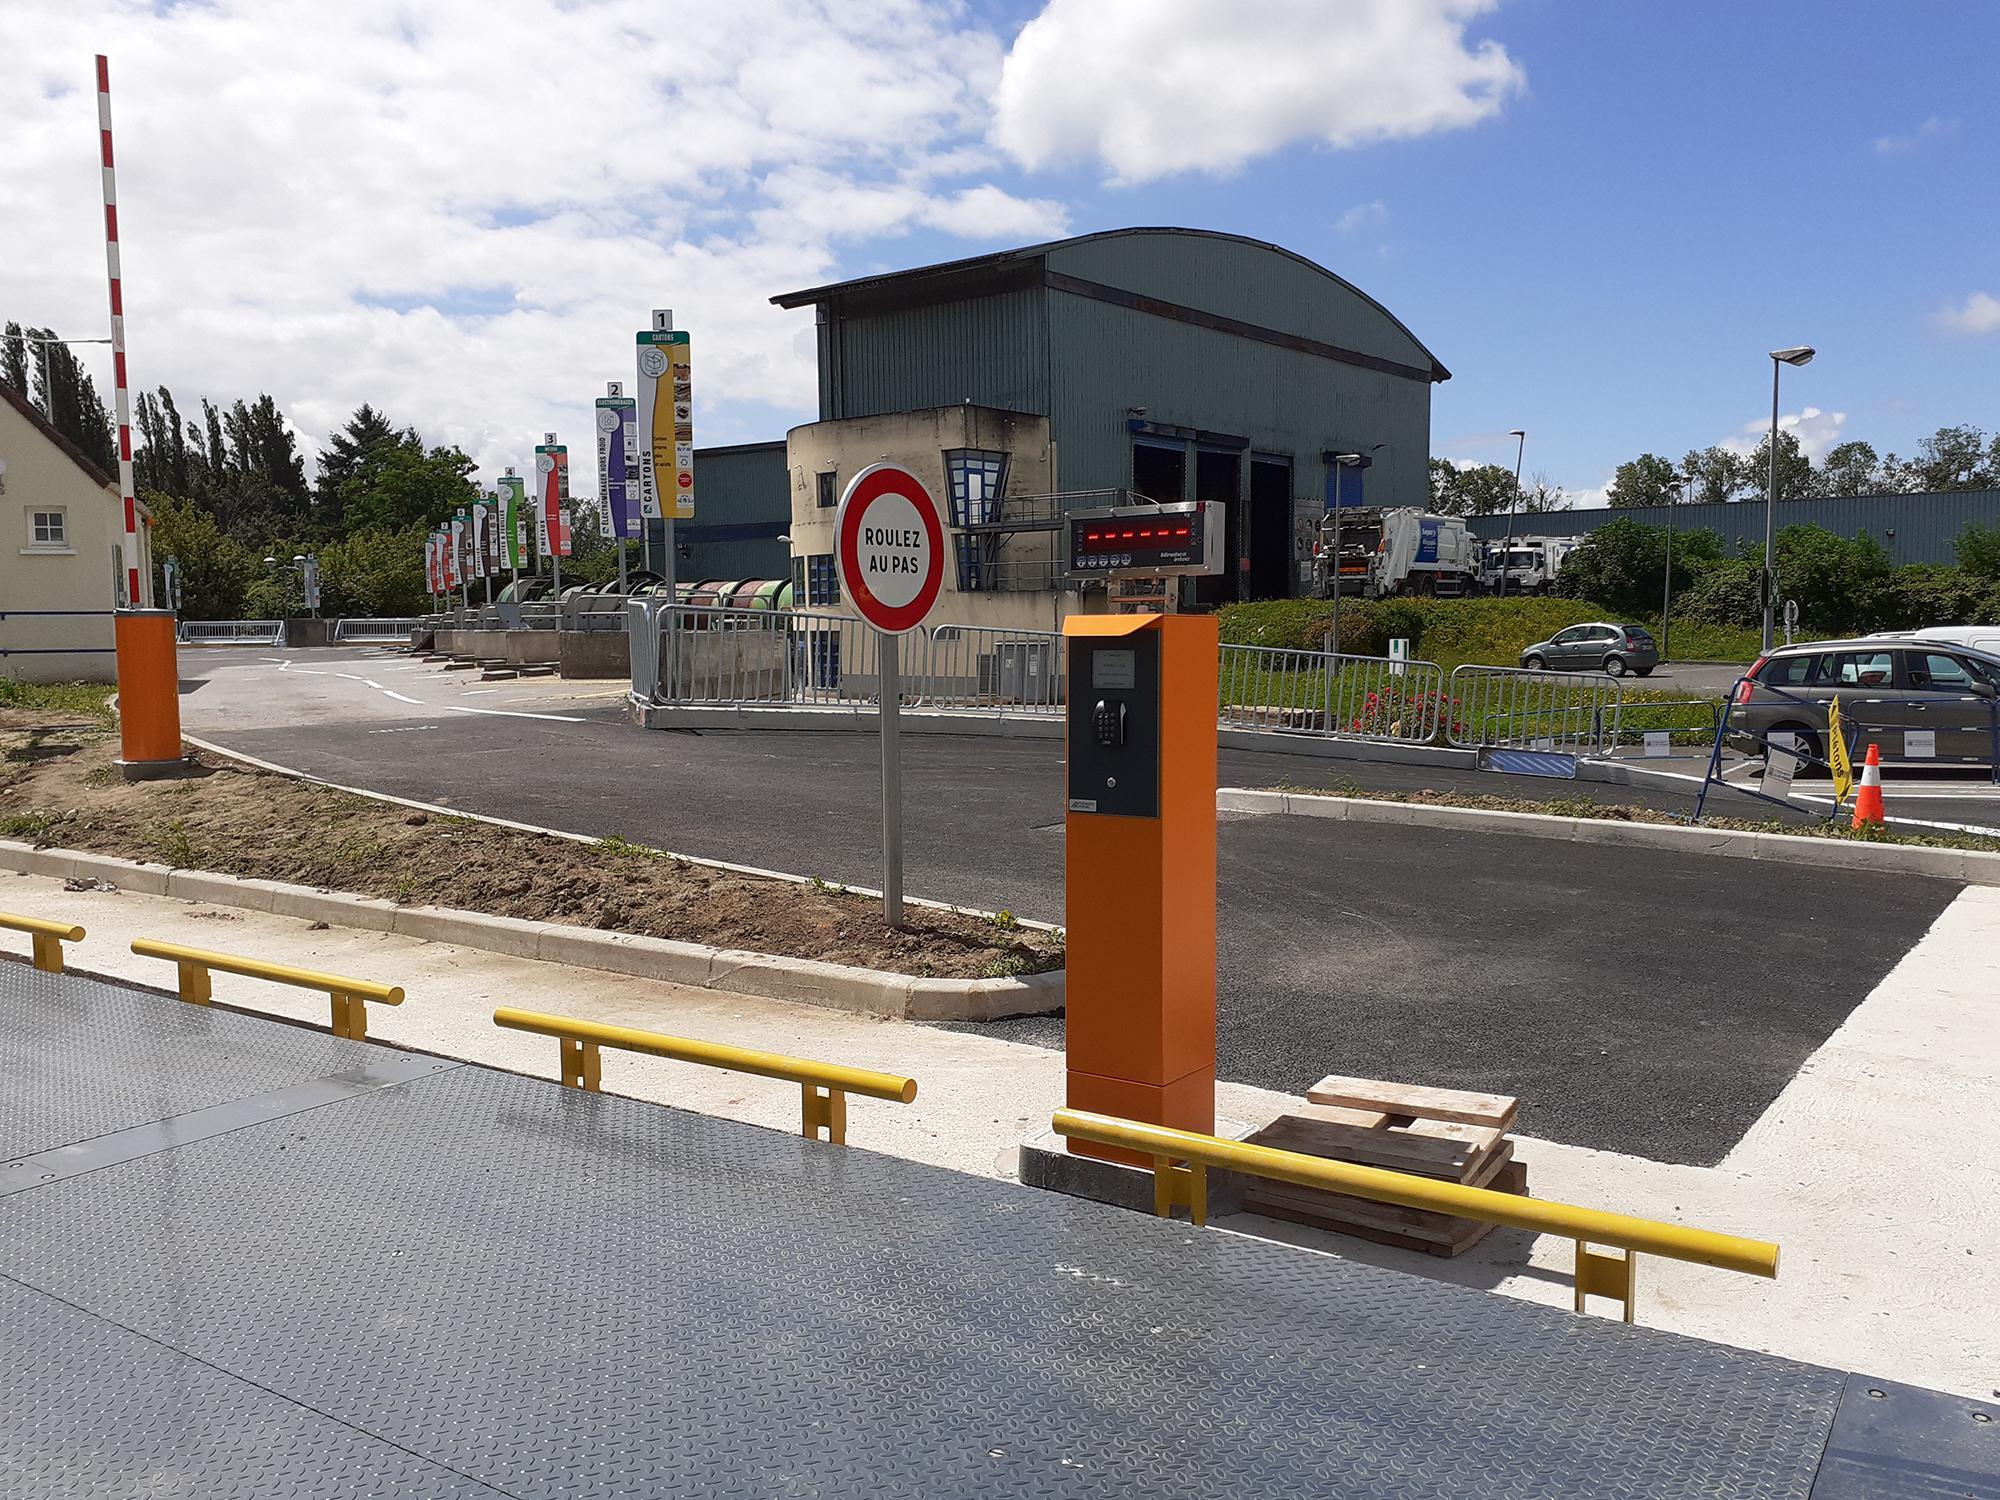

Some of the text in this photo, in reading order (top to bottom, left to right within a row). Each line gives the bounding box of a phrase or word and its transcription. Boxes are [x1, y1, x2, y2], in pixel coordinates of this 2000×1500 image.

[658, 313, 665, 327] 1
[611, 384, 619, 396] 2
[547, 434, 554, 444] 3
[599, 456, 607, 472] HORS
[506, 468, 513, 476] 4
[643, 451, 652, 502] CARTONS
[865, 528, 921, 548] ROULEZ
[869, 555, 919, 574] AU PAS
